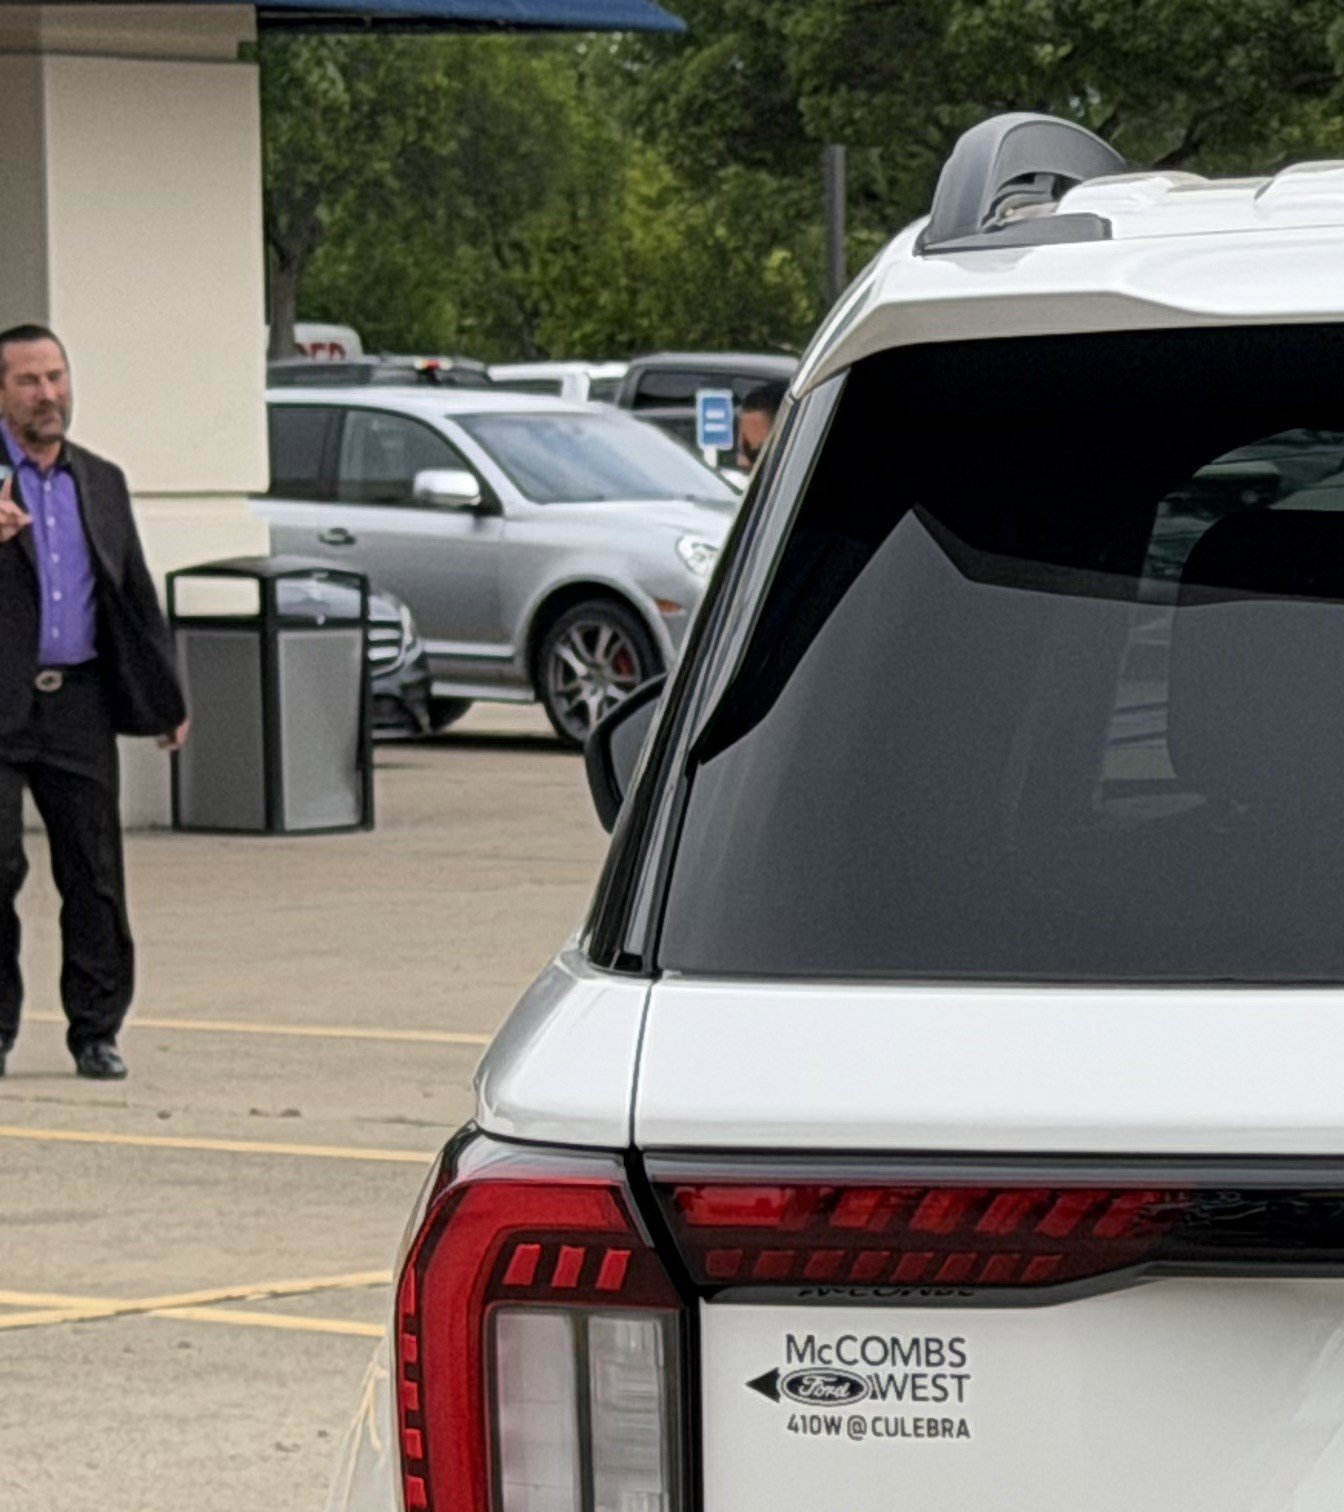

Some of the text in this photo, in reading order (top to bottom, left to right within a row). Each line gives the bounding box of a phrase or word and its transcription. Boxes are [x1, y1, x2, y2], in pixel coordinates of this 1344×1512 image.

[785, 1333, 968, 1369] McCOMBS
[797, 1375, 850, 1399] Ford
[873, 1372, 972, 1403] WEST
